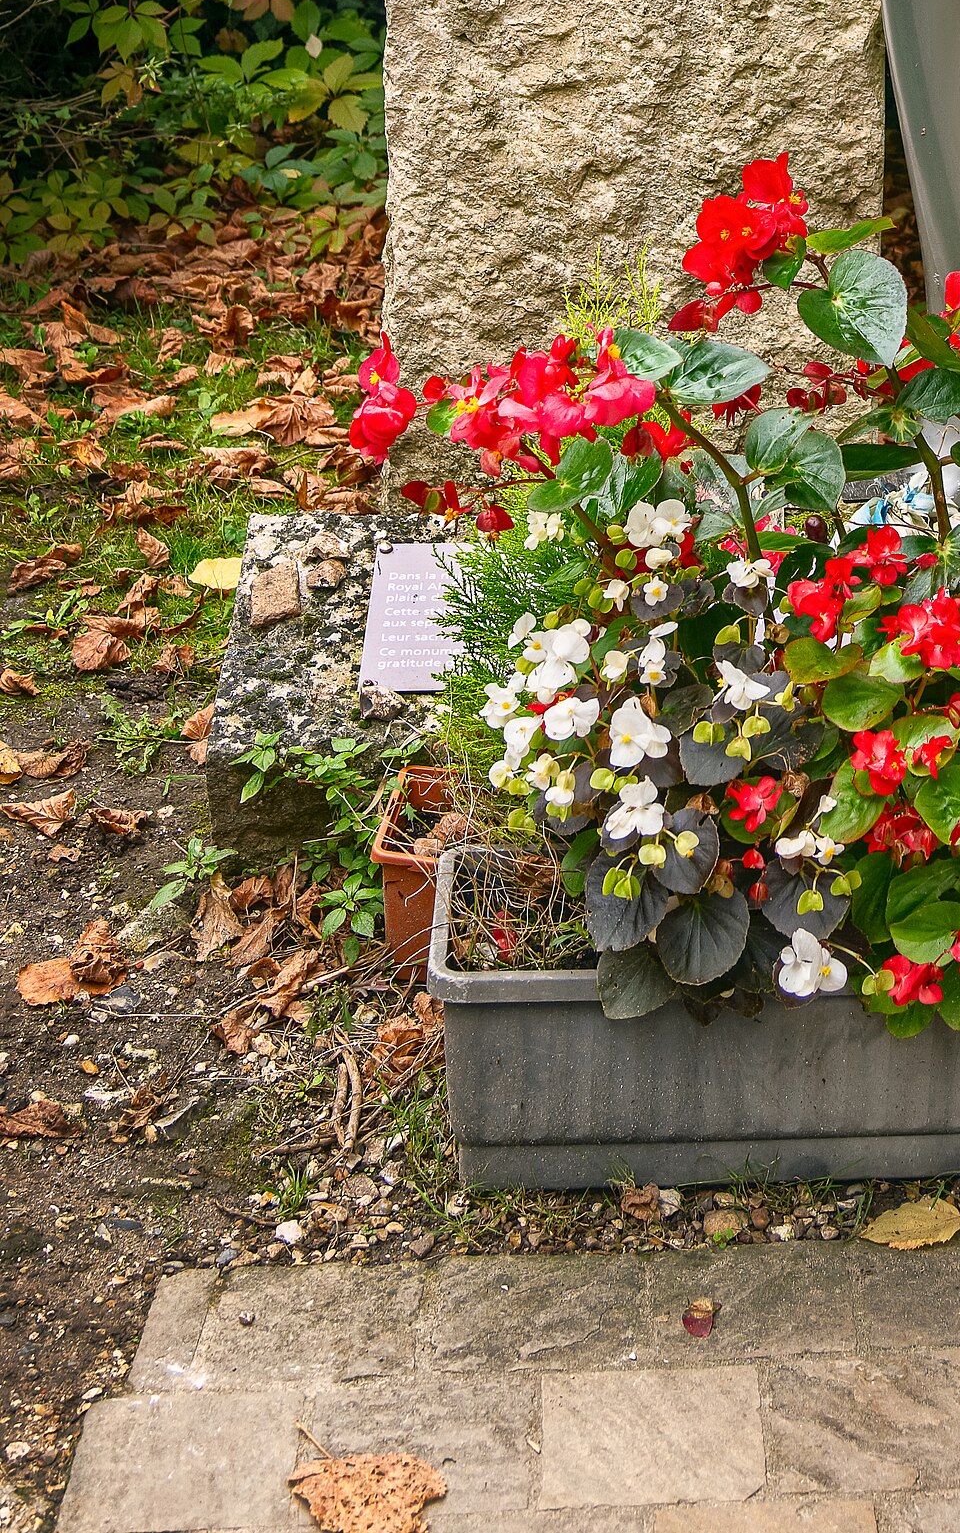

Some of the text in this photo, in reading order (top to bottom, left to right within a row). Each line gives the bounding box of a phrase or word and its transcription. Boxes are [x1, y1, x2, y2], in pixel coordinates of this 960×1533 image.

[389, 572, 421, 580] Dans
[425, 571, 437, 580] la
[387, 582, 423, 593] Royal
[386, 593, 427, 603] plaine
[384, 607, 420, 616] Cette
[381, 633, 411, 642] Leur
[379, 647, 396, 656] Ce
[378, 658, 441, 669] gratitude
